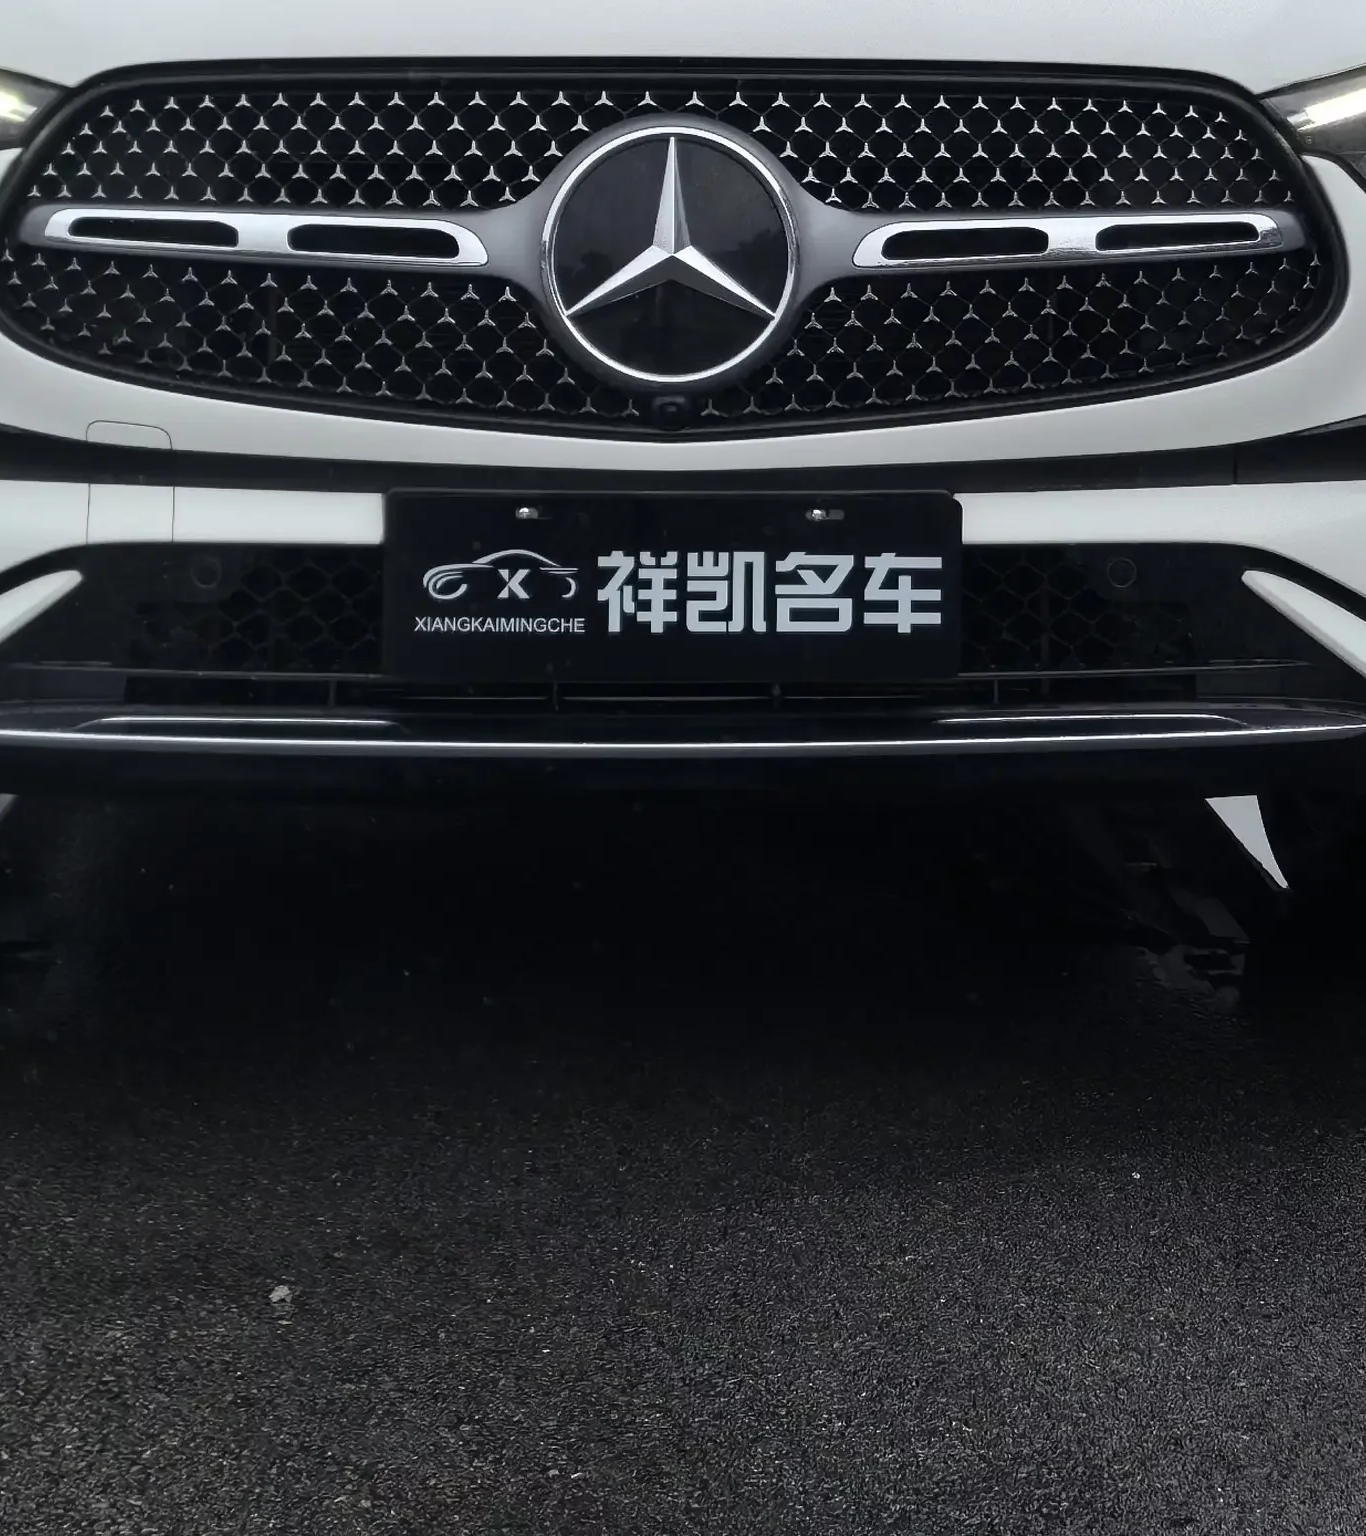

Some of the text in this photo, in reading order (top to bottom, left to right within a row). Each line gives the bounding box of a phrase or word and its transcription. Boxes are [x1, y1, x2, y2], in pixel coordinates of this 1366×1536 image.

[597, 550, 943, 634] 祥凯名车
[414, 616, 586, 633] XIANGKAIMINGCHE
